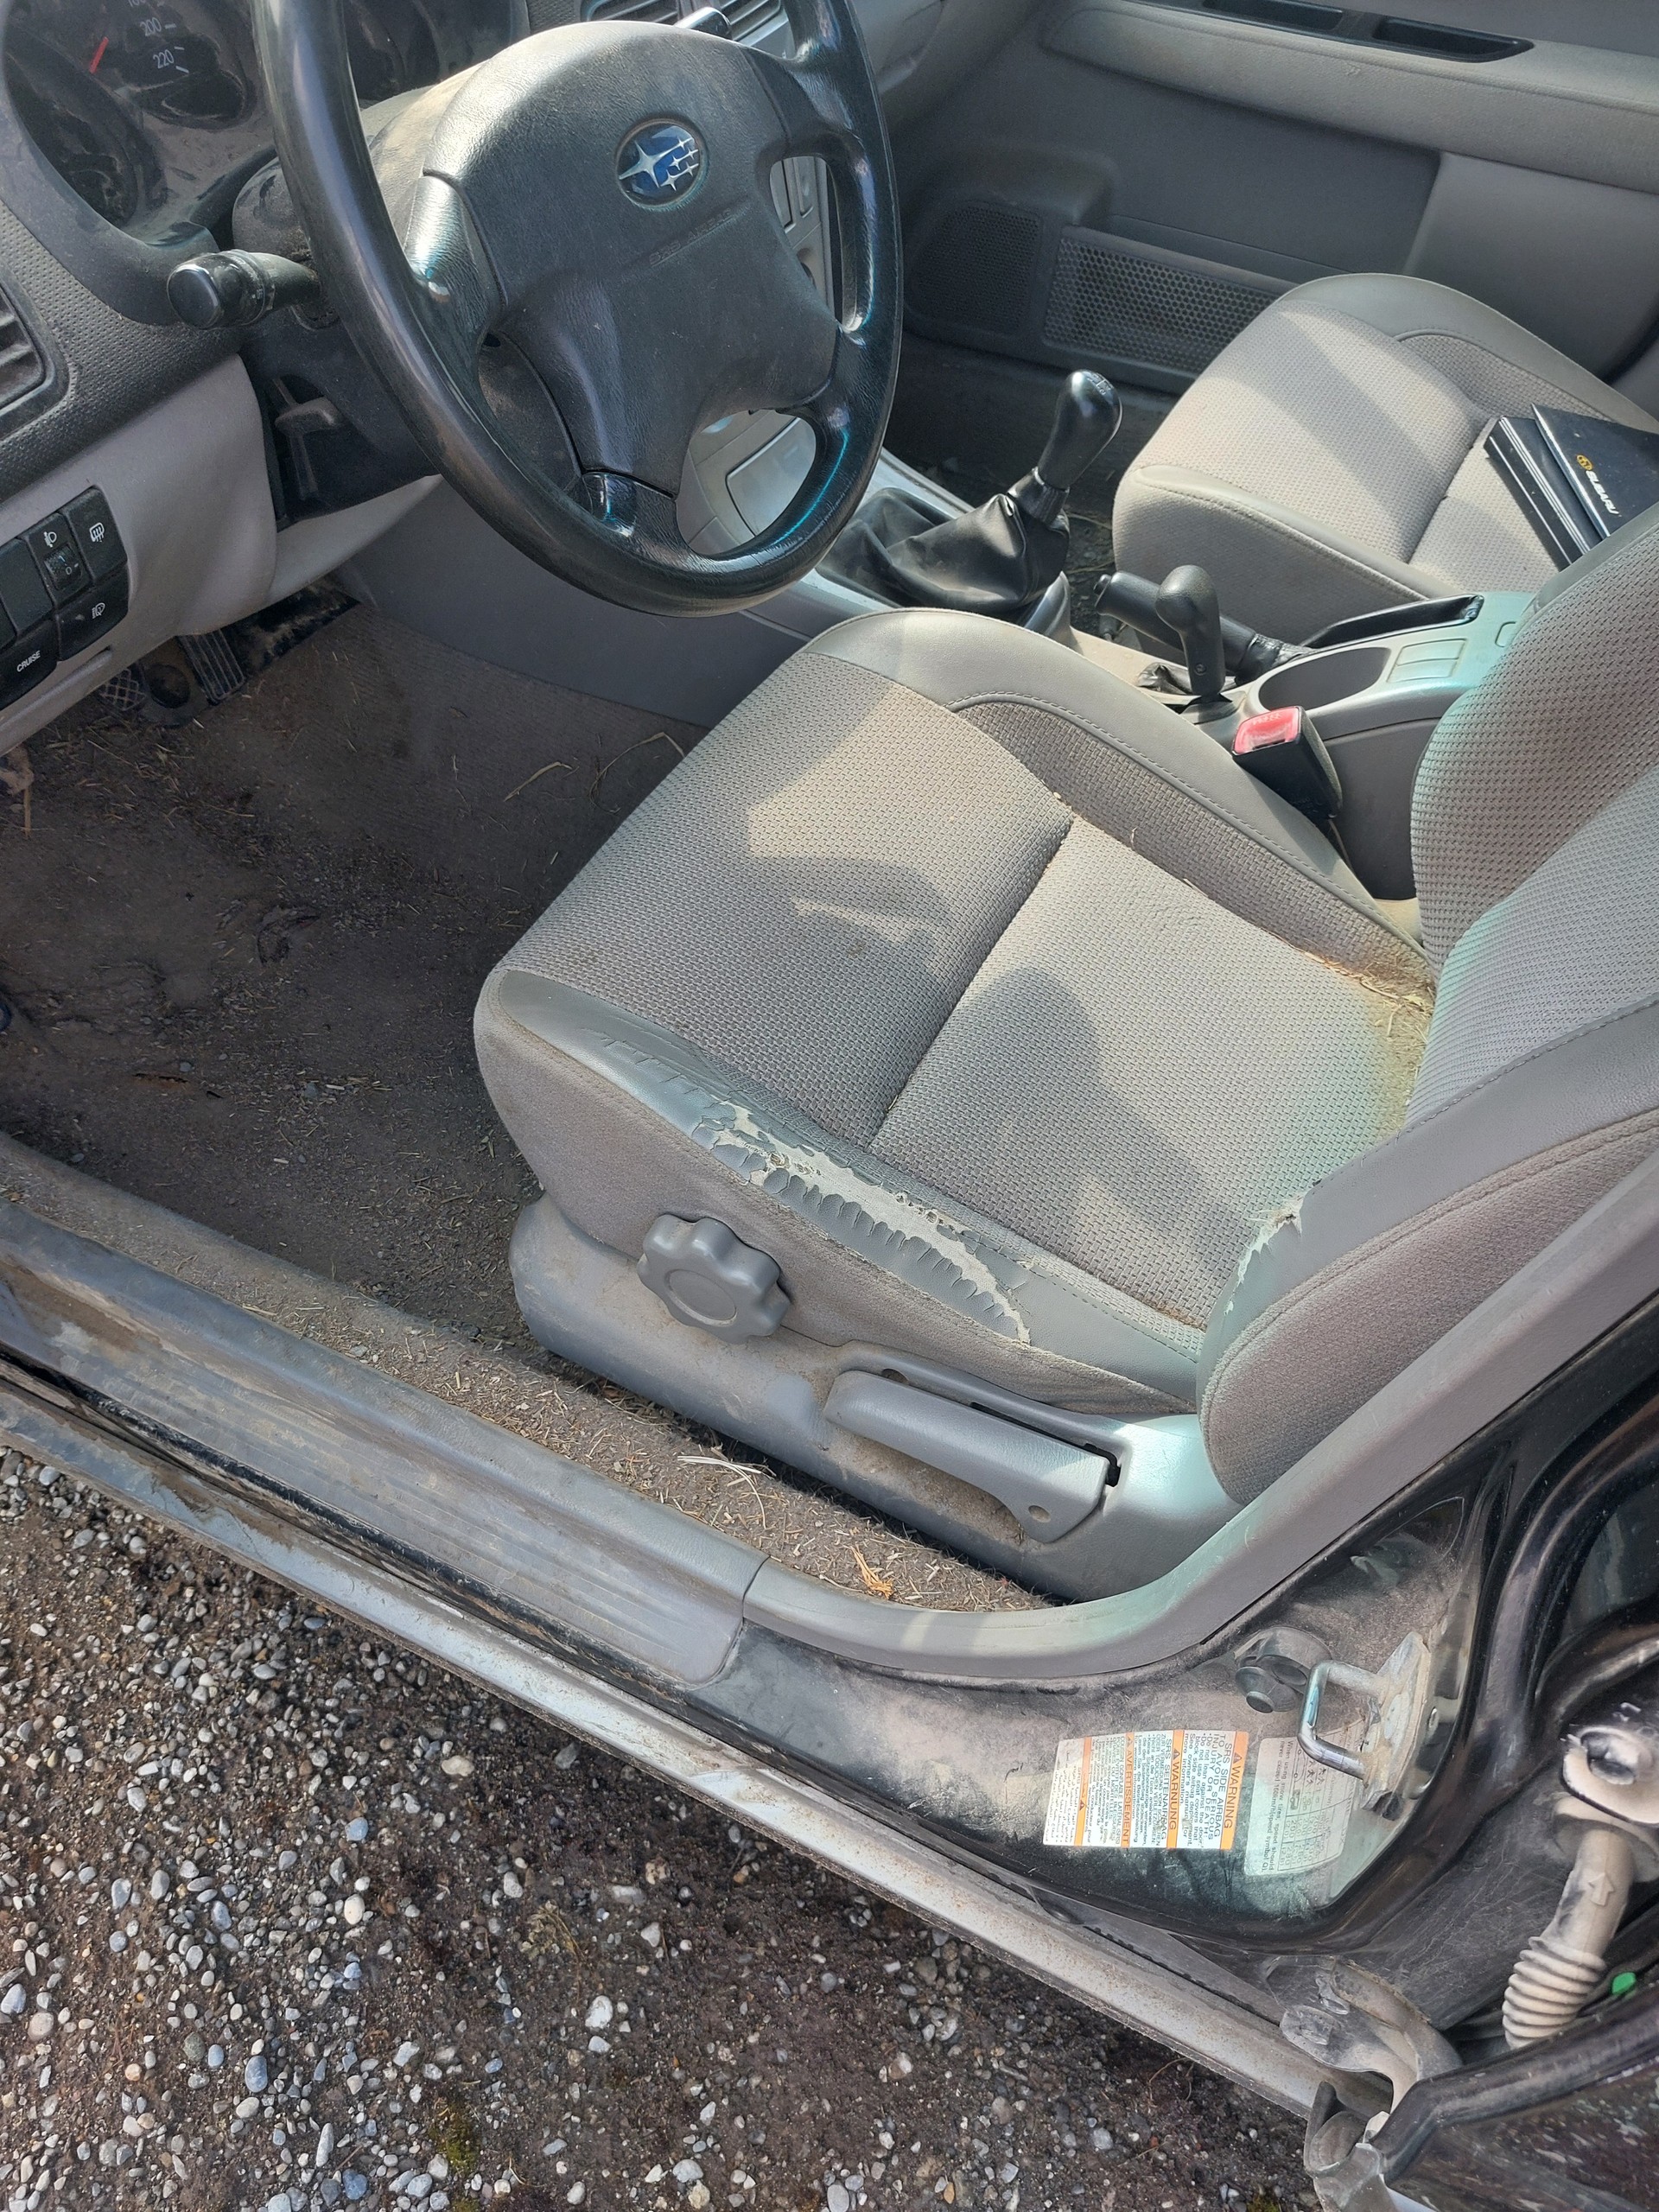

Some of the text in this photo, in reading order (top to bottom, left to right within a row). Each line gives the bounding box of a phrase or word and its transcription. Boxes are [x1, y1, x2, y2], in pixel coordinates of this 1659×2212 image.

[139, 16, 162, 37] 200
[152, 49, 175, 69] 220
[1585, 470, 1620, 515] SUBARU
[16, 650, 41, 672] CRUISE
[1209, 1733, 1219, 1770] INJURY
[1286, 1740, 1294, 1759] When
[1206, 1733, 1225, 1839] TO AVOID SERIOUS
[1207, 1777, 1213, 1790] OR
[1281, 1762, 1289, 1779] using
[1122, 1750, 1132, 1844] AVERTISSEMENT
[1169, 1761, 1180, 1829] WARNUNG
[1213, 1743, 1232, 1836] SRS SIDE AIRBAG
[1224, 1765, 1241, 1828] WARNING
